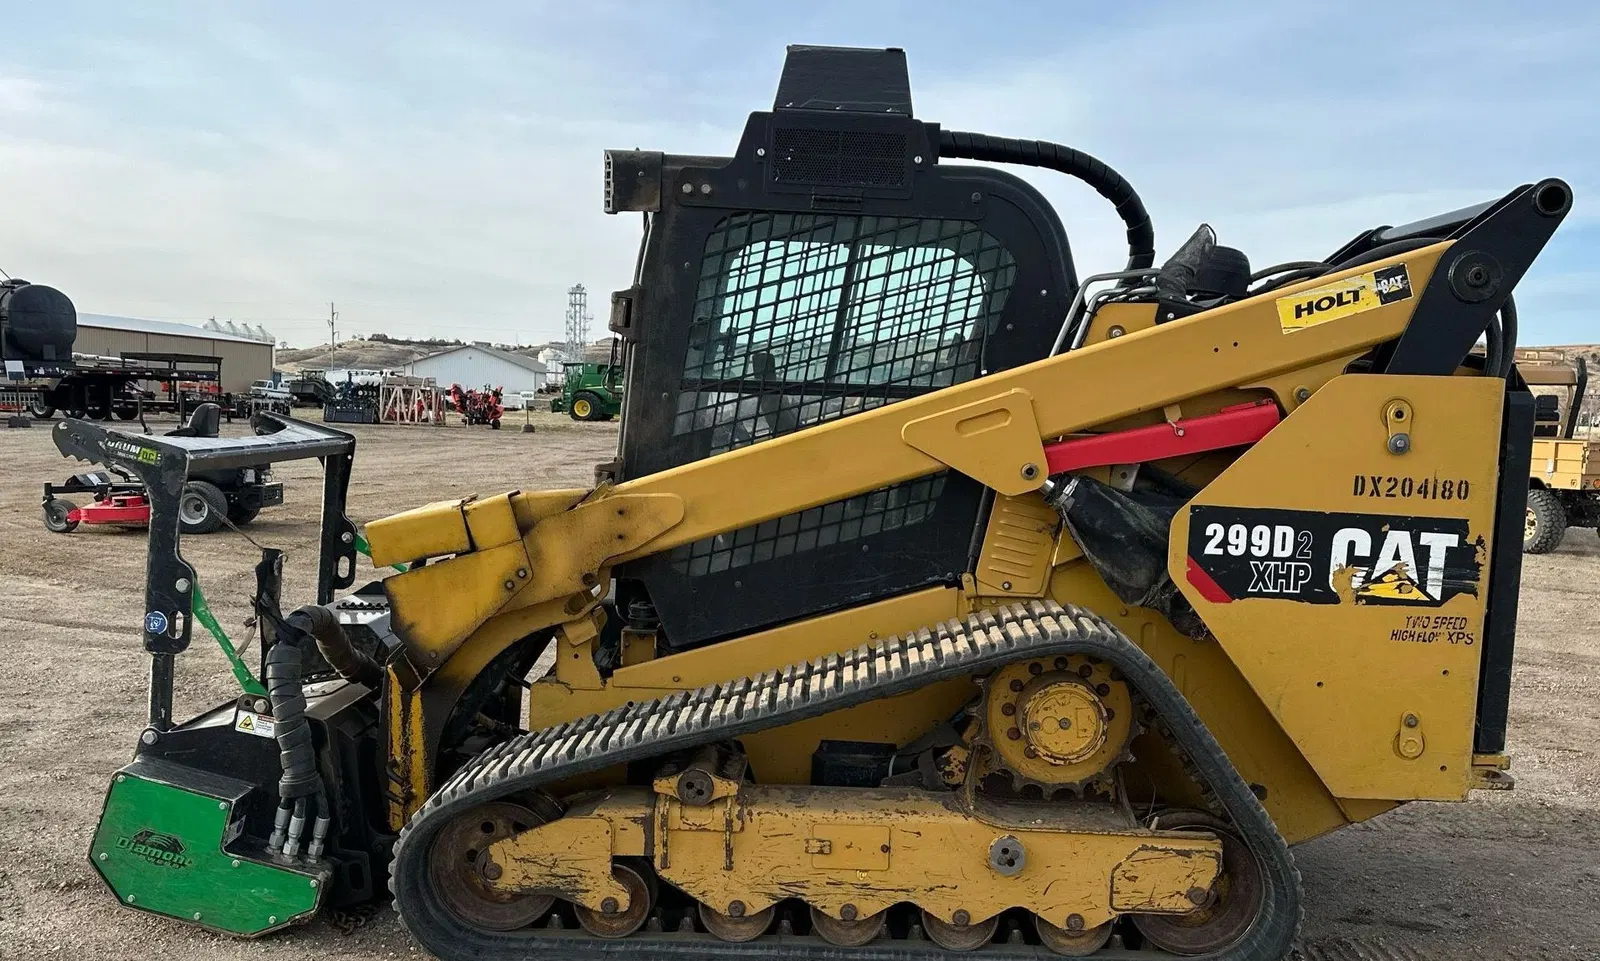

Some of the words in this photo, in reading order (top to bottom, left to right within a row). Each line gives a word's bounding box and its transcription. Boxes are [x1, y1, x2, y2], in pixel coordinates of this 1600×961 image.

[1295, 286, 1365, 319] HOLT
[1353, 475, 1470, 500] DX204180
[1247, 561, 1312, 593] XHP
[1329, 527, 1459, 601] CAT
[1390, 629, 1416, 642] HIGH
[1447, 631, 1474, 645] XPS
